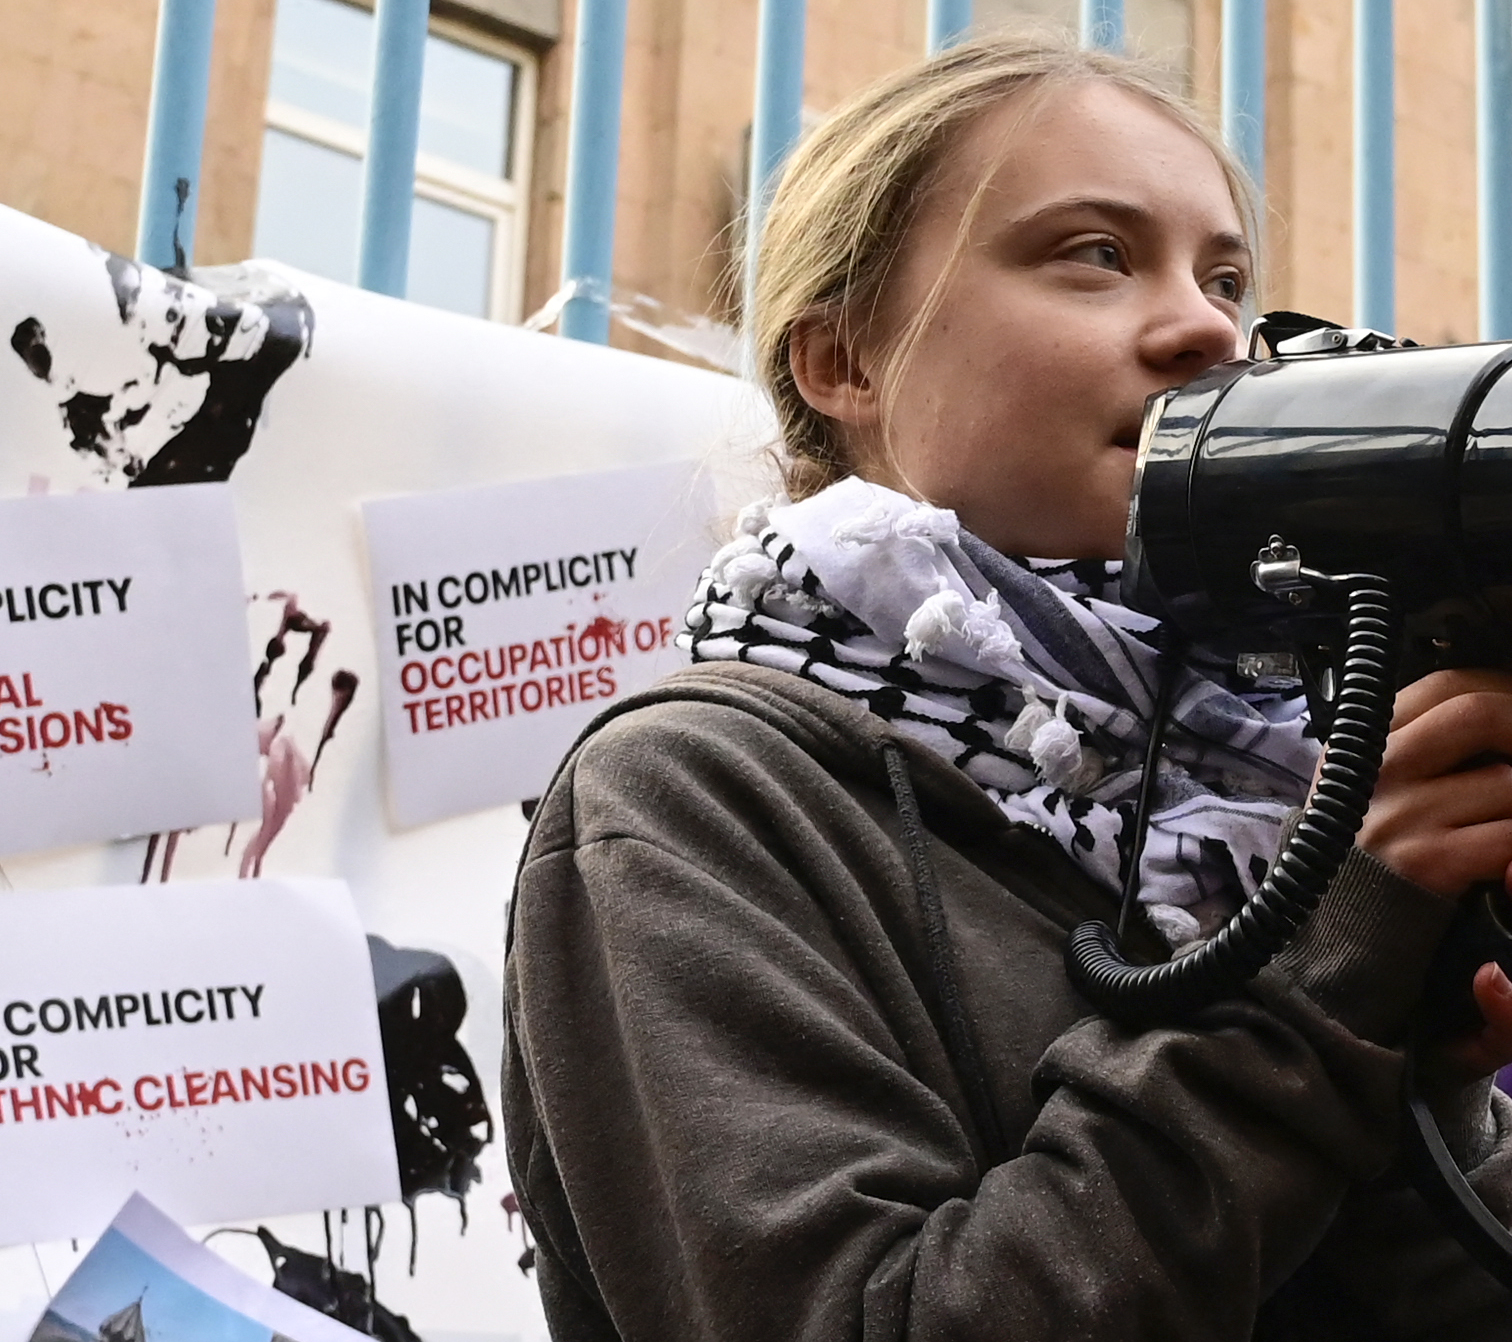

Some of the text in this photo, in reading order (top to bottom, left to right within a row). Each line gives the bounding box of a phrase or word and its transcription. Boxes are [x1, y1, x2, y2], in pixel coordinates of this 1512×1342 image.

[392, 547, 638, 616] IN COMPLICITY
[396, 615, 466, 656] FOR
[400, 616, 673, 694] OCCUPATION OF
[403, 666, 618, 734] TERRITORIES
[3, 984, 265, 1037] COMPLICITY
[133, 1057, 371, 1112] CLEANSING
